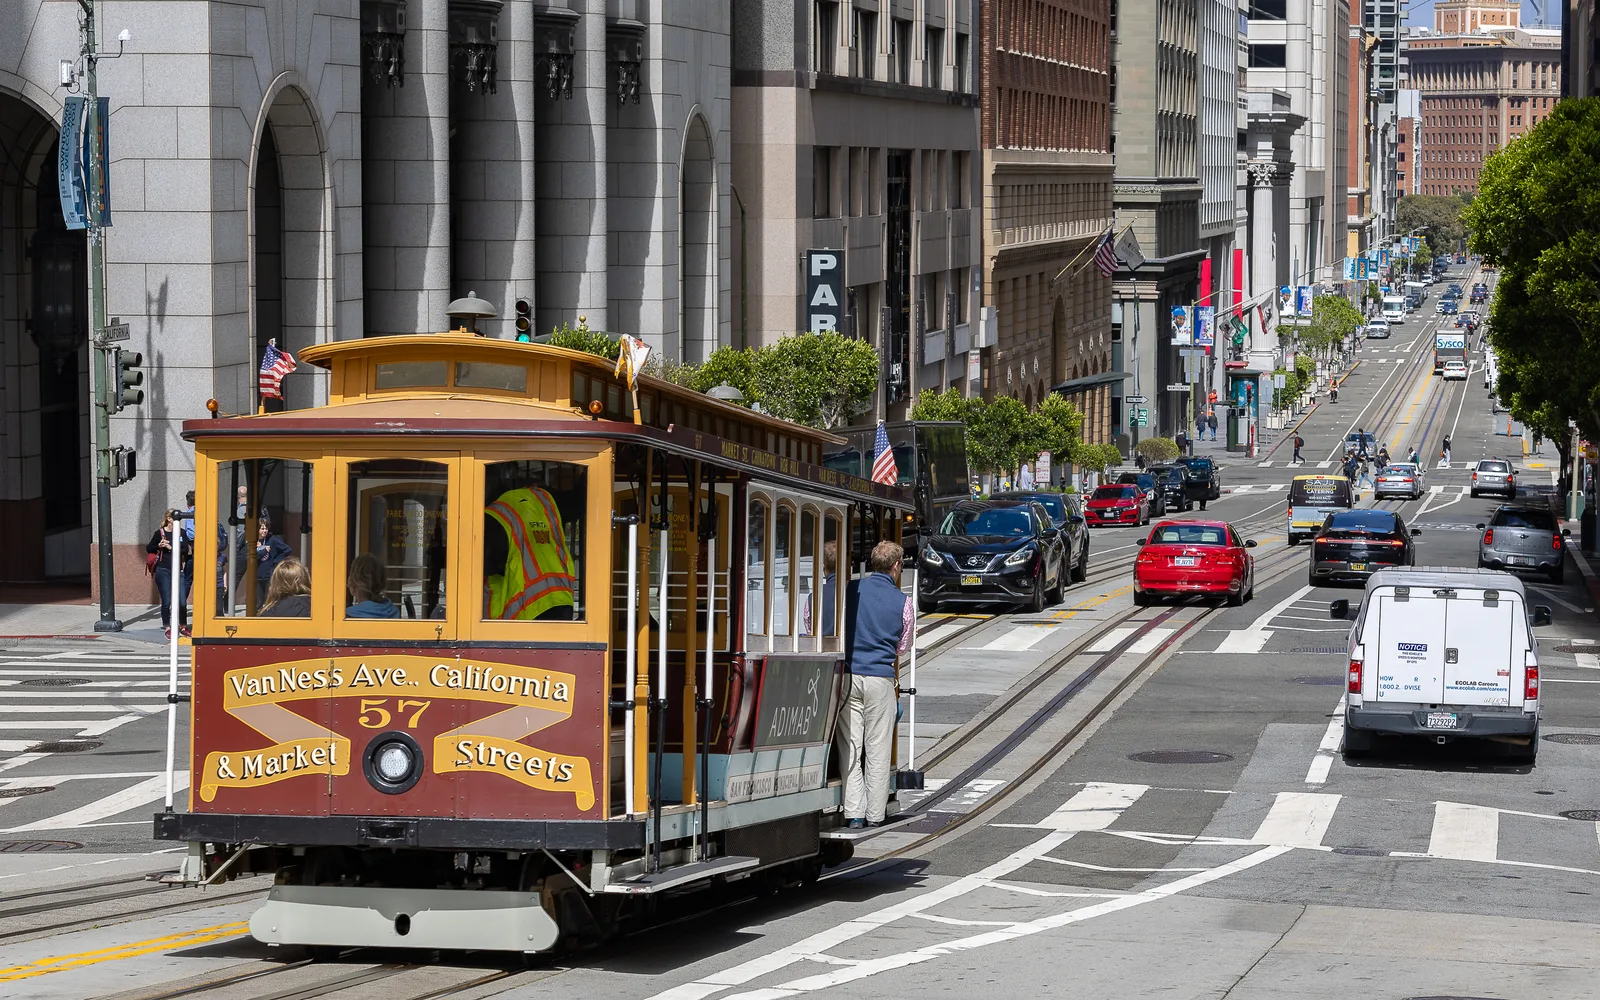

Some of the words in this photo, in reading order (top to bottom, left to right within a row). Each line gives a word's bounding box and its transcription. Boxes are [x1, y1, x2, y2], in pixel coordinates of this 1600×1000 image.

[60, 103, 70, 182] DOWNTOWN
[64, 103, 74, 170] WELCOMES
[1437, 338, 1464, 349] Sysco
[721, 440, 740, 460] MARKET
[751, 449, 776, 470] CHINATOWN
[789, 460, 799, 476] HILL
[1398, 643, 1427, 652] NOTICE
[229, 673, 276, 698] Van
[277, 666, 344, 692] Ness
[430, 664, 569, 702] California
[358, 698, 431, 729] 57
[768, 706, 811, 738] ADIMAB
[217, 754, 236, 779] &
[240, 743, 337, 780] Market
[455, 740, 574, 783] Streets
[730, 781, 741, 798] SAN
[741, 777, 772, 797] FRANCISCO
